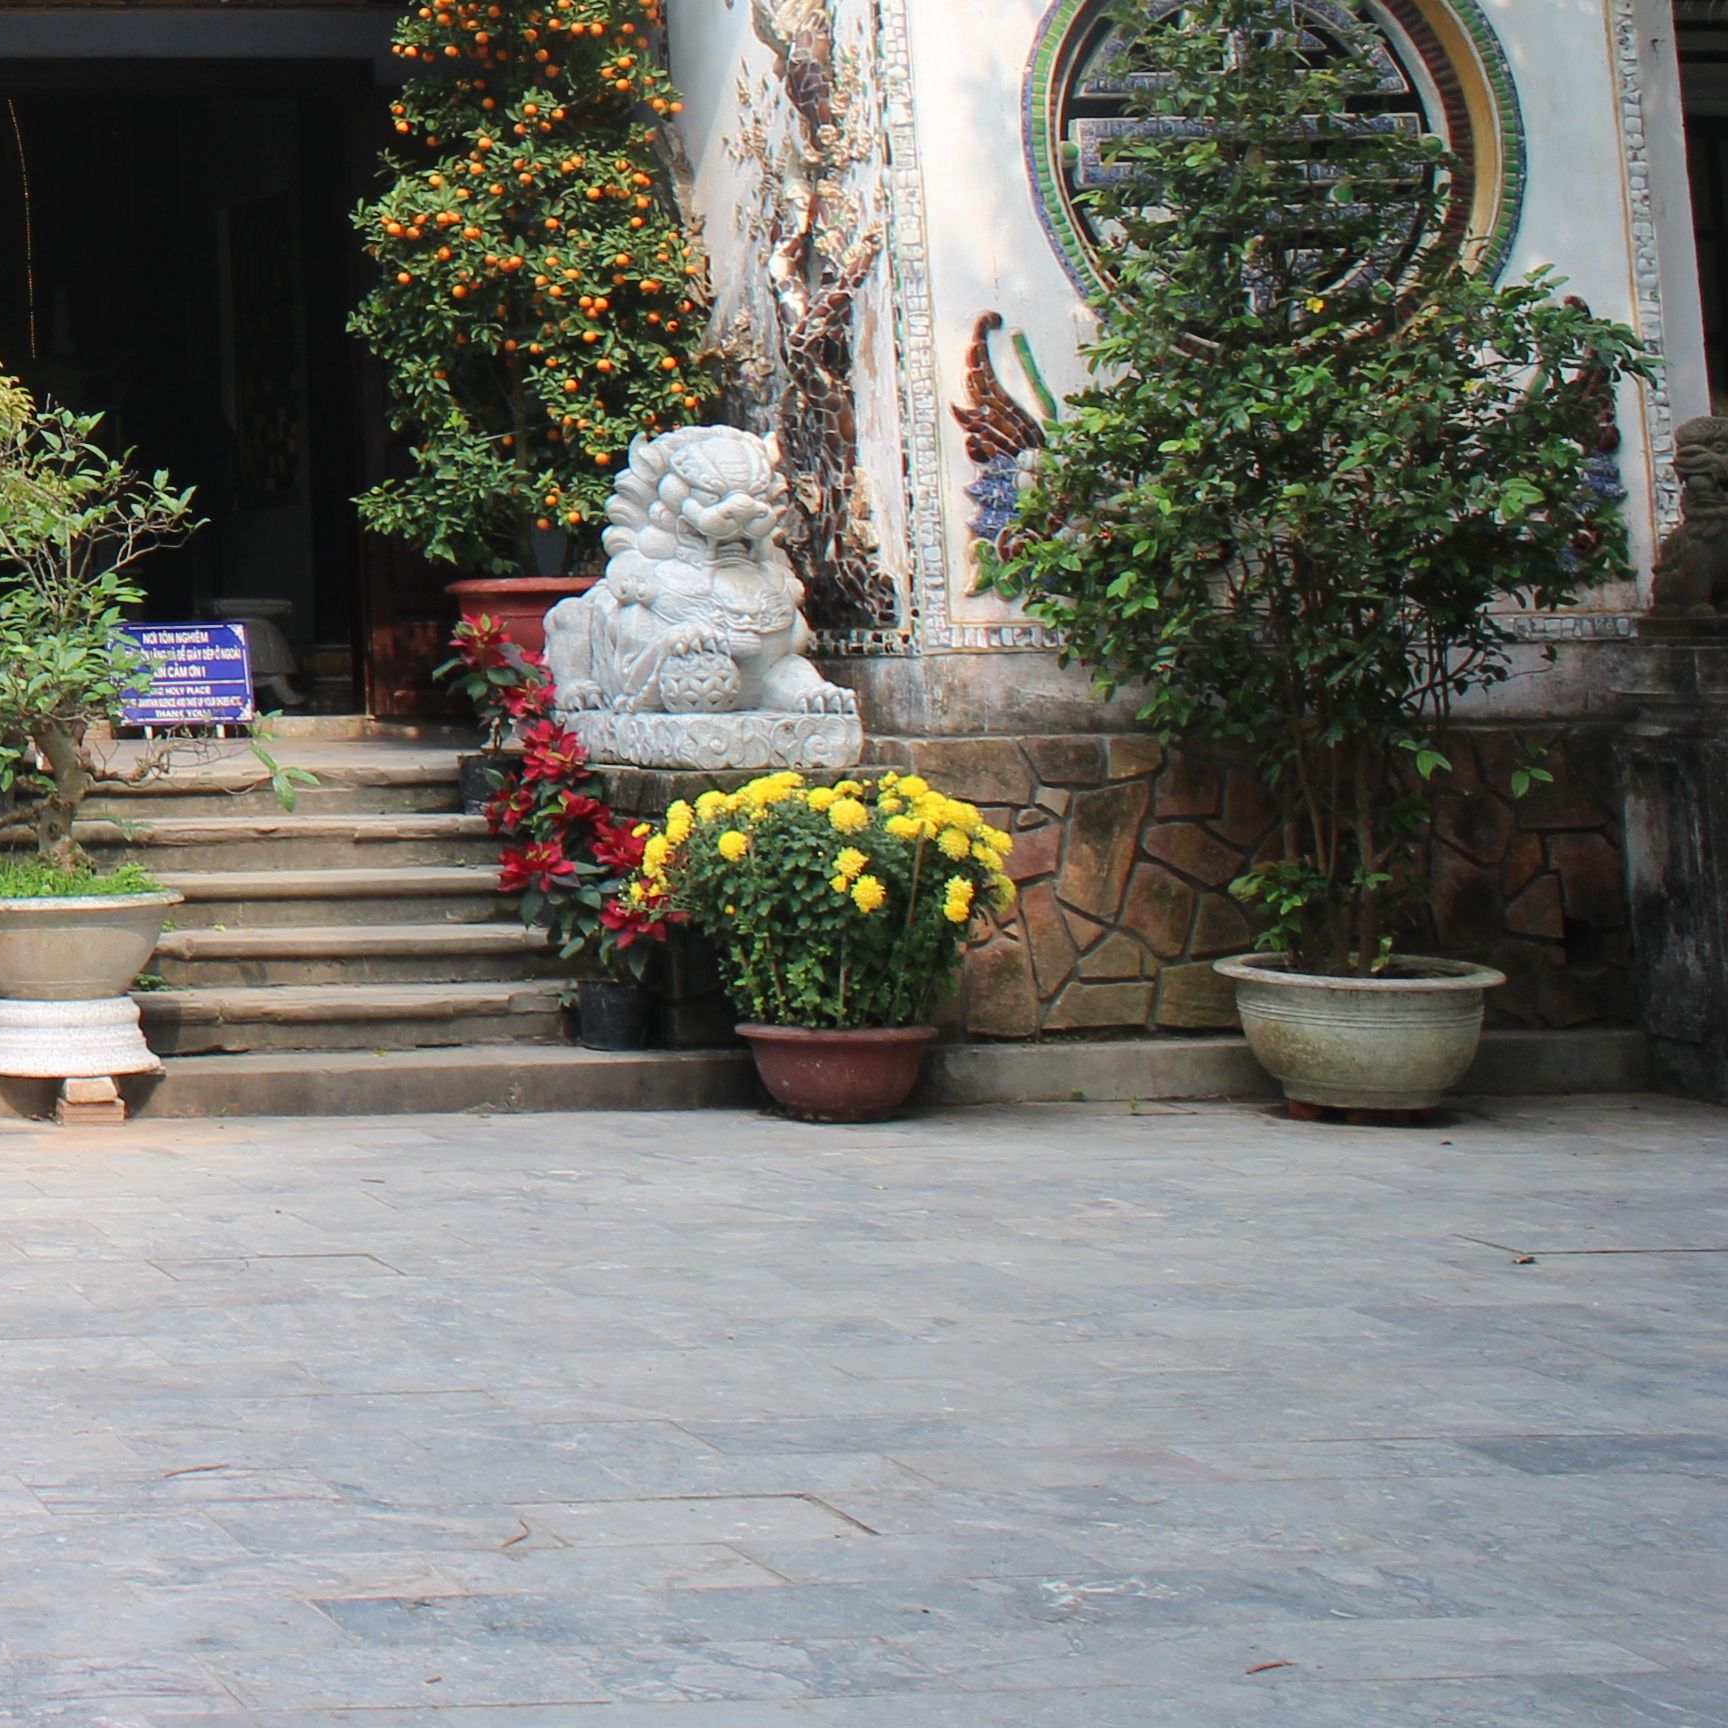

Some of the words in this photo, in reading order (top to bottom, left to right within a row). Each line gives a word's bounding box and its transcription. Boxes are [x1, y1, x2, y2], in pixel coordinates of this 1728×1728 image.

[158, 630, 175, 644] TÔN
[175, 629, 208, 644] NGHIÊM
[167, 662, 188, 678] CẢM
[165, 686, 185, 695] HOLY
[186, 685, 211, 695] PLACE
[155, 709, 184, 718] THANK
